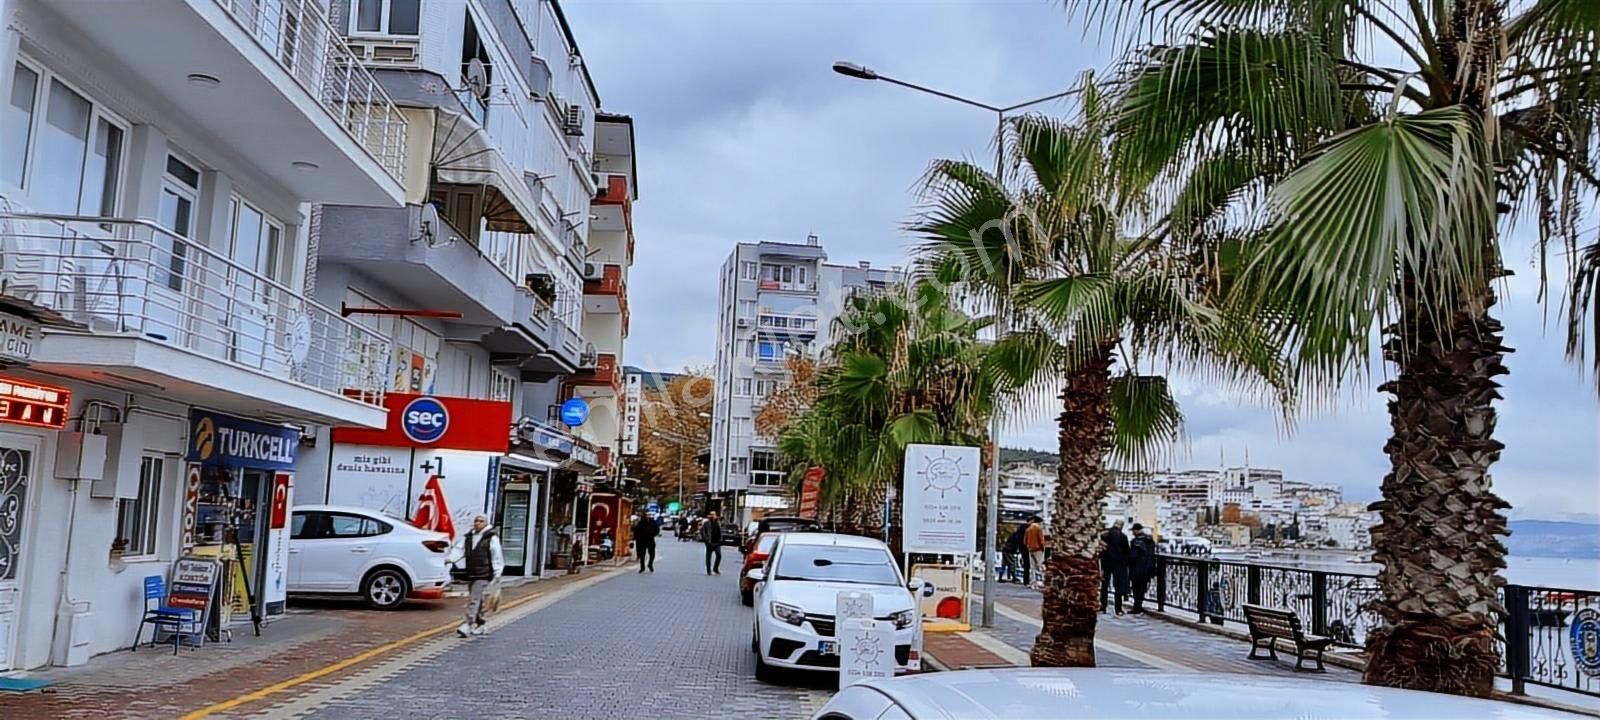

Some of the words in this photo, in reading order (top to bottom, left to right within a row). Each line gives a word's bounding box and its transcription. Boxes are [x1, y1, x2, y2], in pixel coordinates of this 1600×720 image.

[408, 410, 444, 428] seç
[626, 404, 637, 453] HOTEL
[218, 427, 293, 464] TURKCELL
